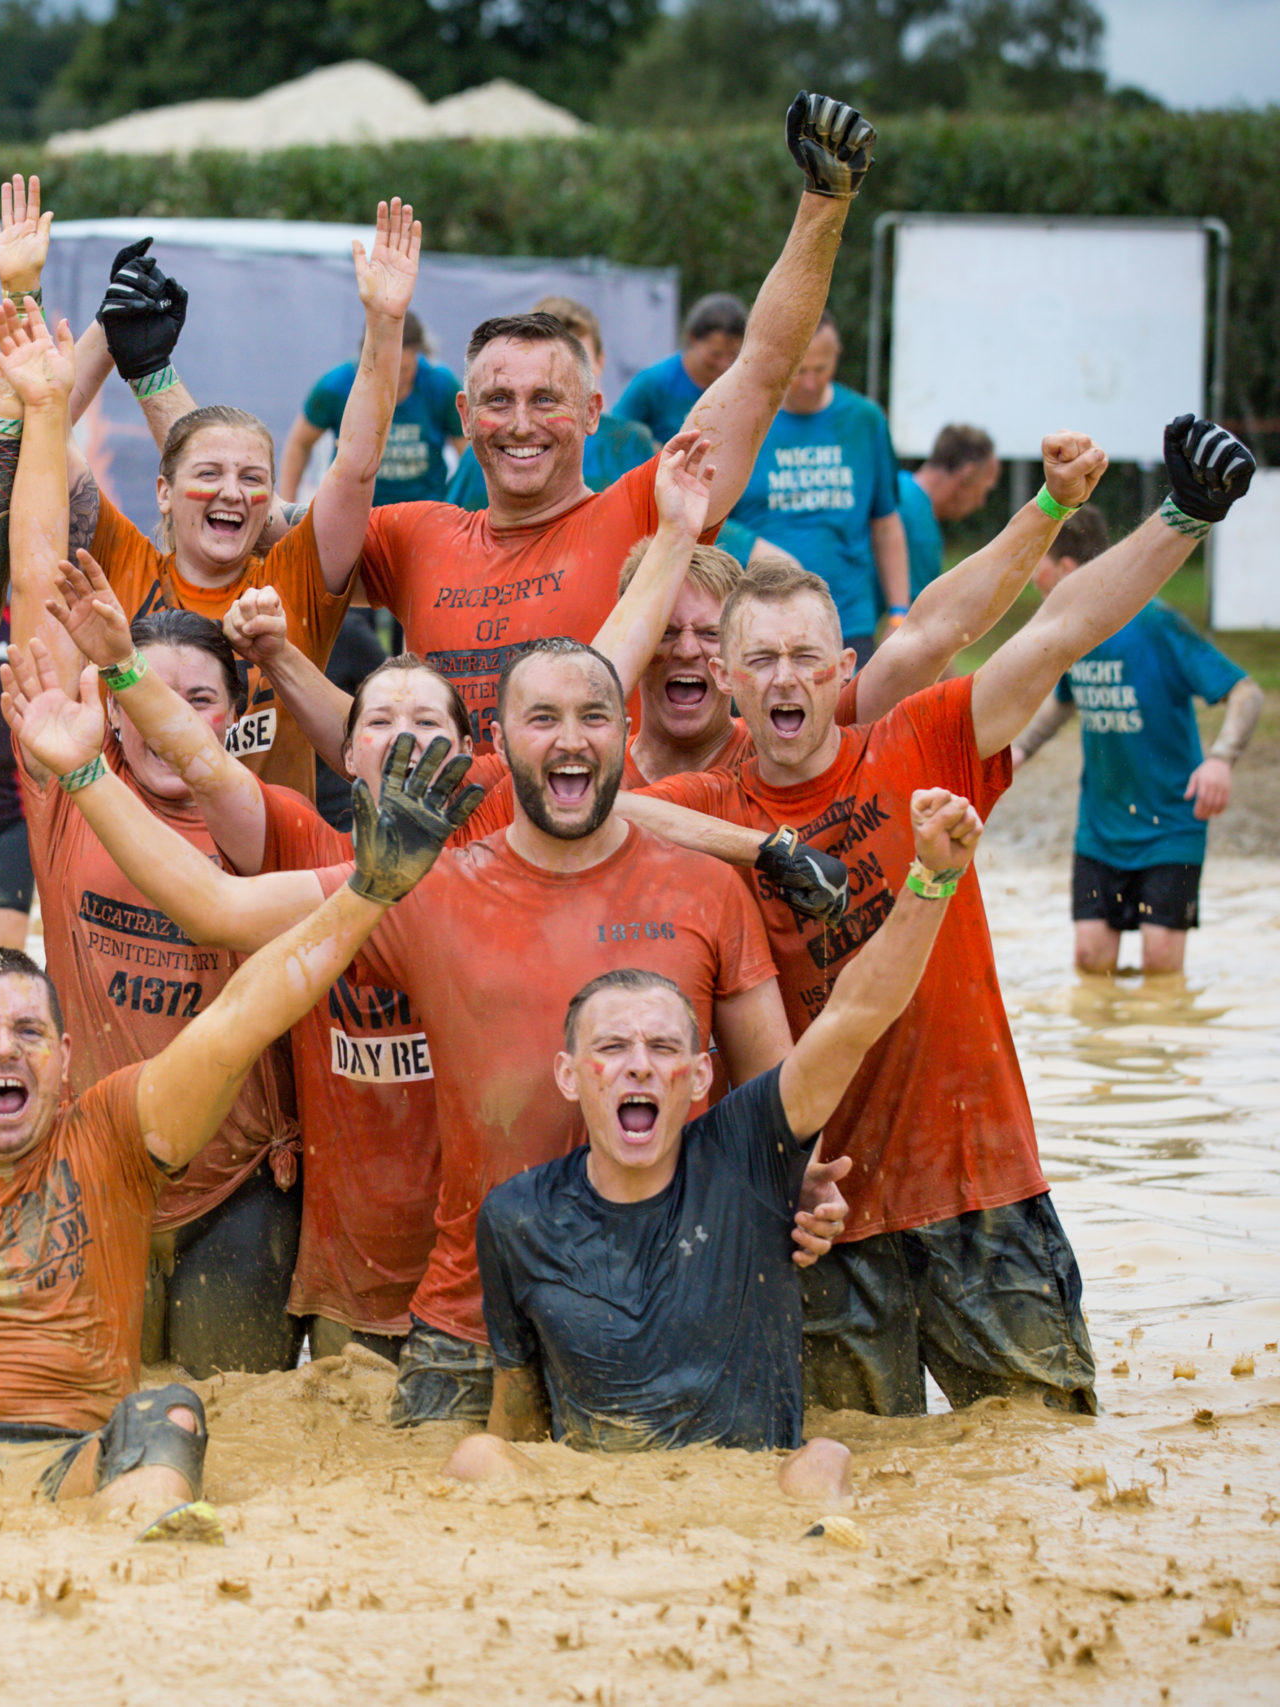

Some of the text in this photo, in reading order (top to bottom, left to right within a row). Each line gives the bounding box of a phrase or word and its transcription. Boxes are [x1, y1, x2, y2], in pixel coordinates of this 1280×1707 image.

[433, 569, 566, 609] PROPERTY
[476, 616, 510, 642] OF
[225, 714, 272, 753] ASE
[80, 896, 172, 937] ALCATRAZ
[88, 931, 220, 972] PENITENTIARY
[107, 970, 204, 1018] 41372
[336, 1034, 431, 1077] DAY RE
